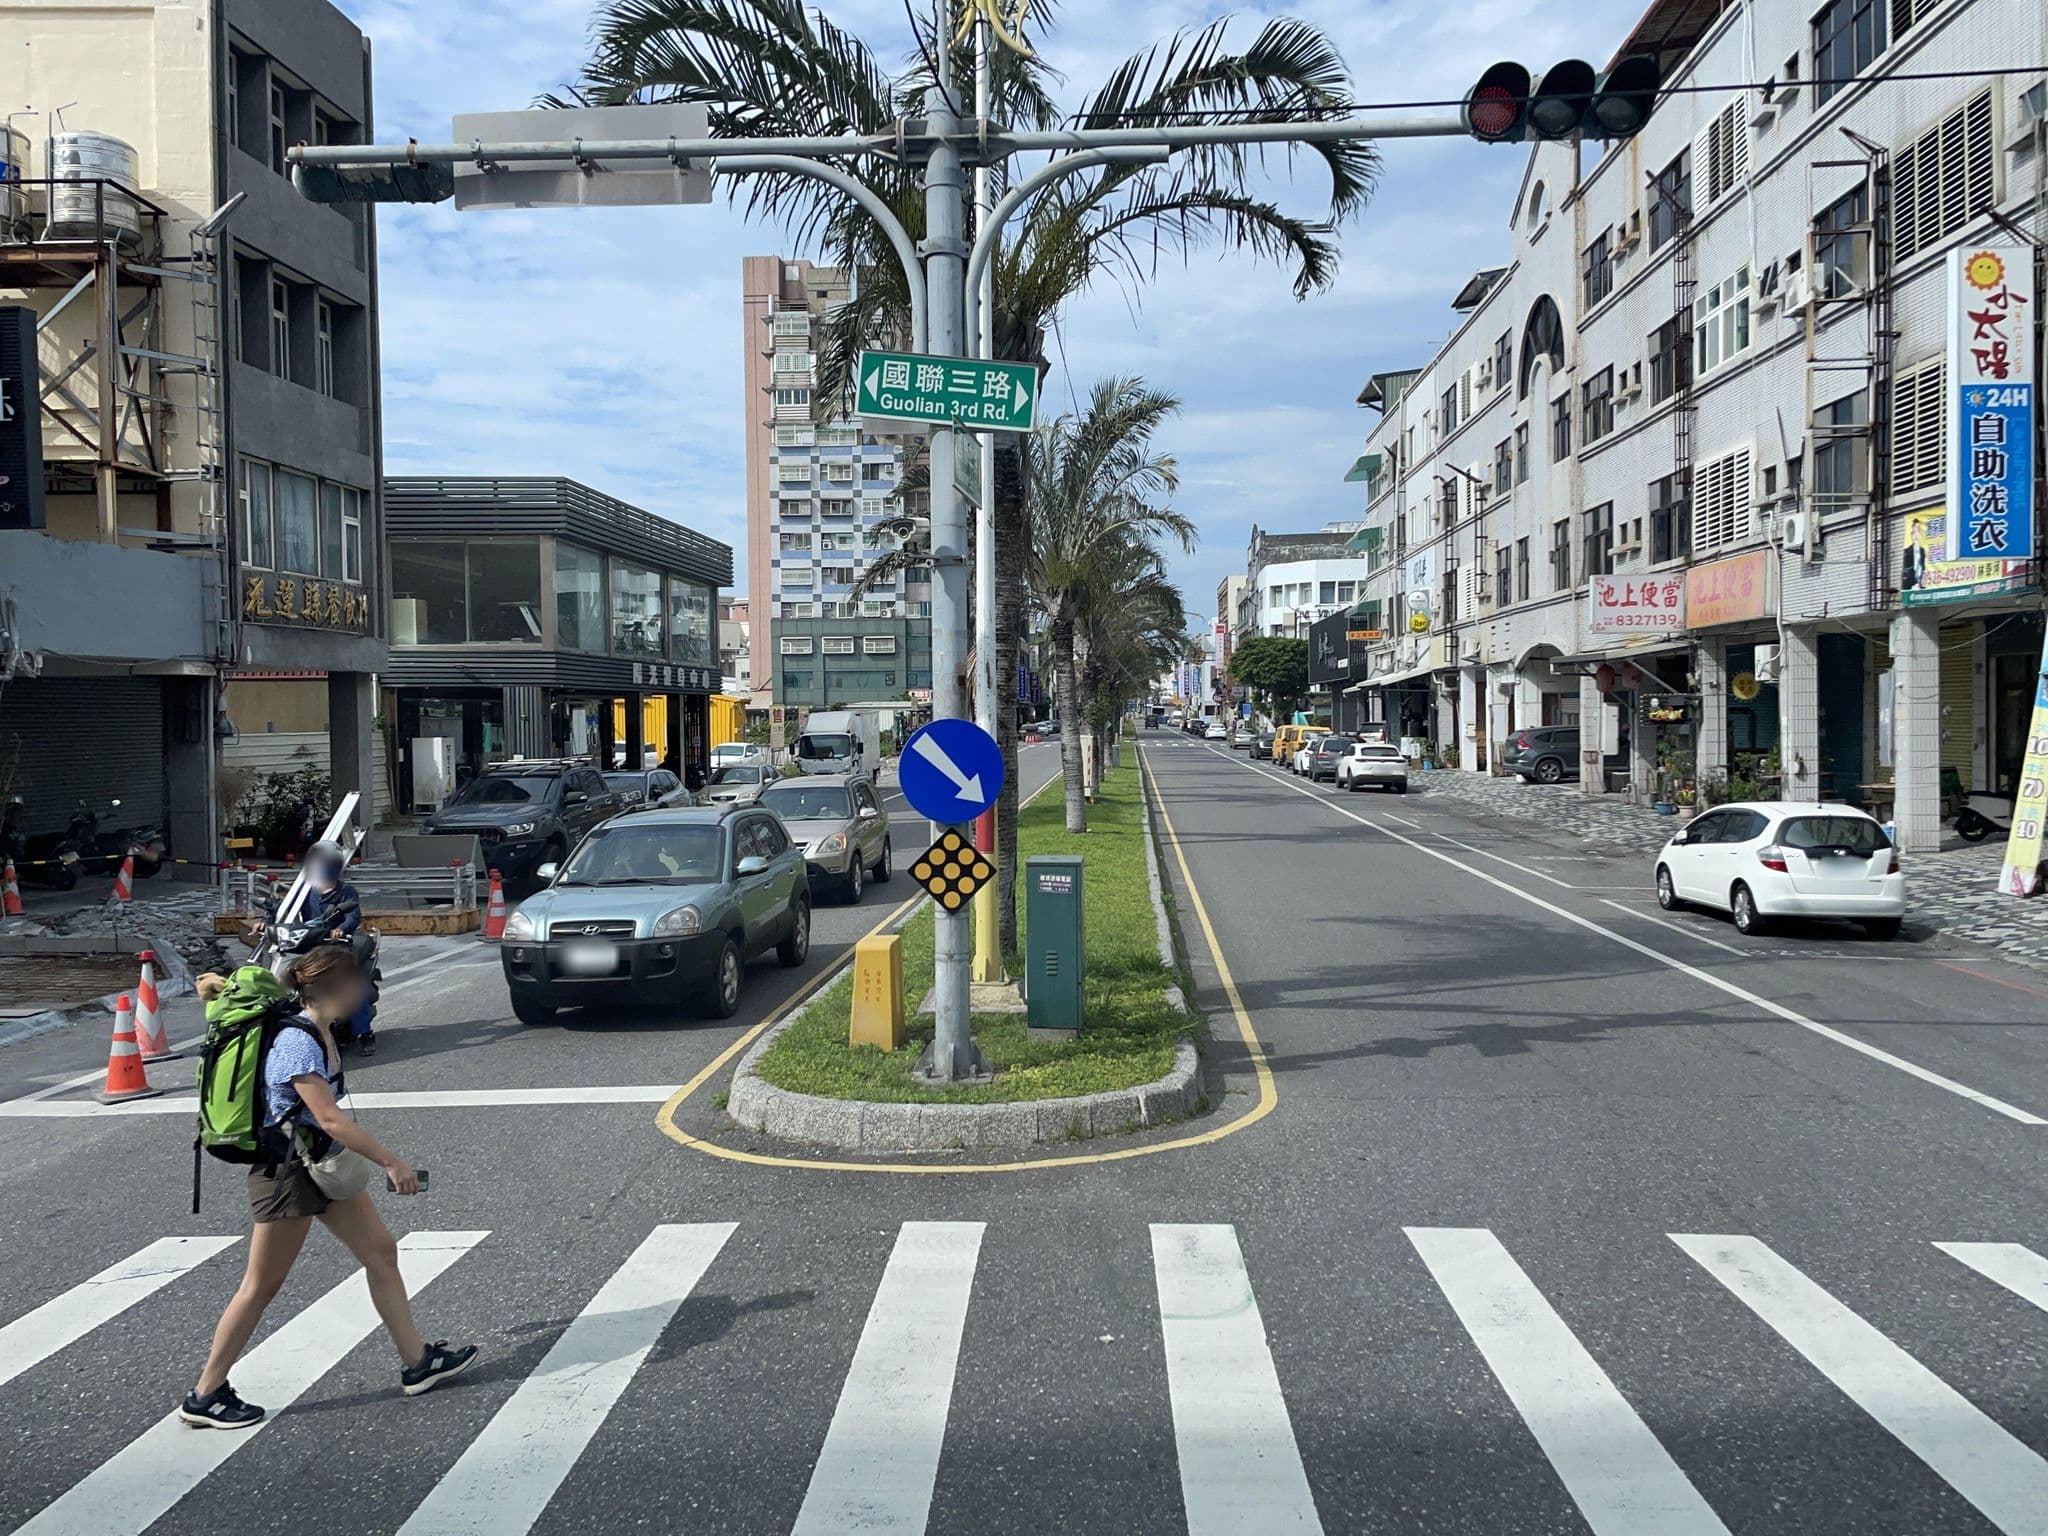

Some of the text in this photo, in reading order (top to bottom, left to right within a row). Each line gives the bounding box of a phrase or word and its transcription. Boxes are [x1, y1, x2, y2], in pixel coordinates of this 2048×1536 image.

[1967, 284, 2028, 380] 小太陽
[881, 359, 1012, 401] 國聯三路
[880, 393, 1010, 421] Guolian 3rd Rd.
[1986, 388, 2028, 408] 24H
[1969, 411, 2009, 552] 自助洗衣
[1598, 580, 1681, 608] 池上便當
[1616, 614, 1677, 626] 8327139
